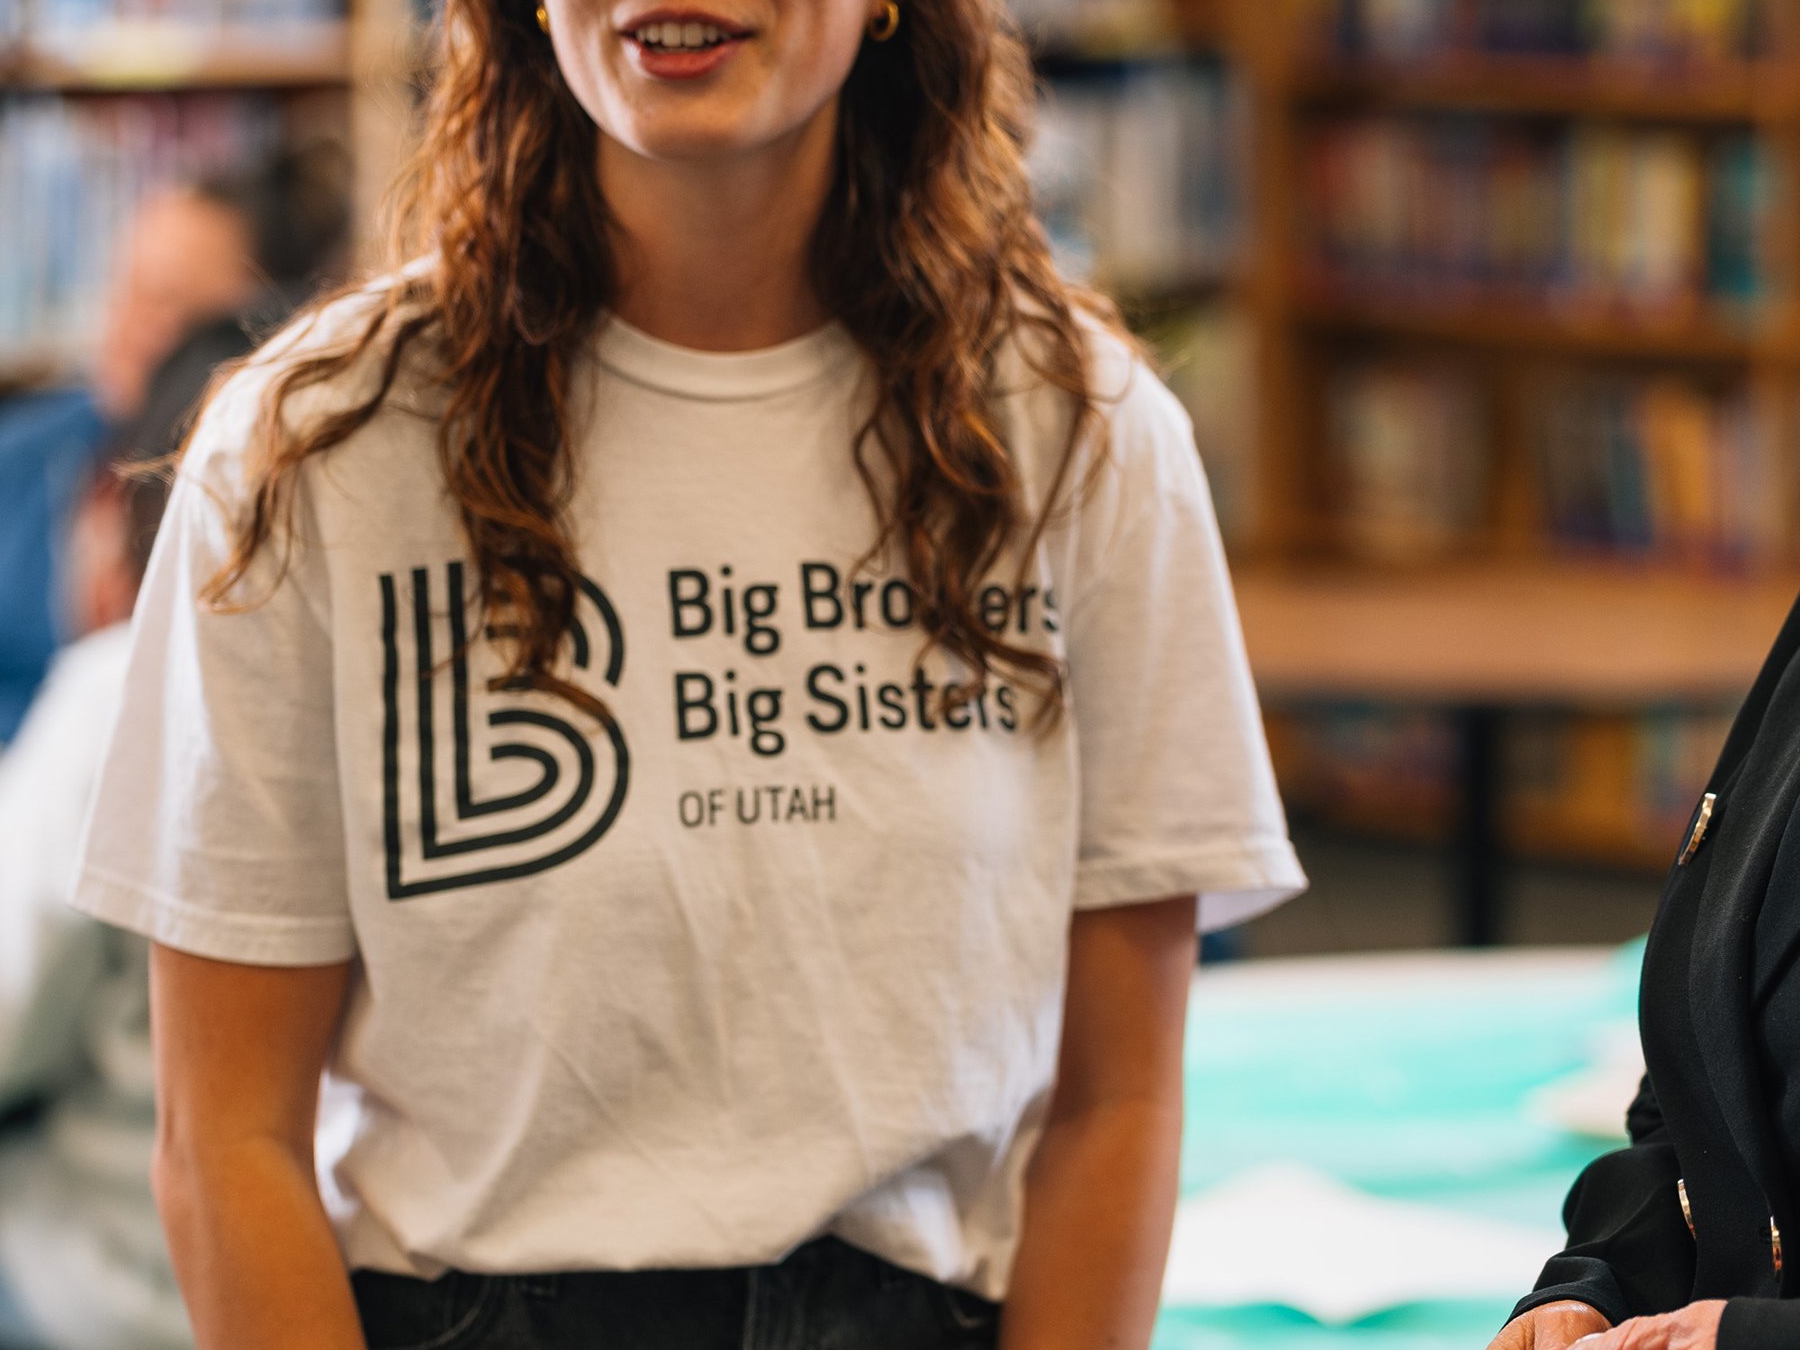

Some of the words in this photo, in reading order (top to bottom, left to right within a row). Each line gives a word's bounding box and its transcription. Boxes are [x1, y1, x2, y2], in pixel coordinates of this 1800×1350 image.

[668, 565, 781, 657] Big
[802, 561, 1061, 636] Broers
[674, 670, 787, 758] Big
[678, 789, 728, 829] OF
[736, 784, 837, 826] UTAH
